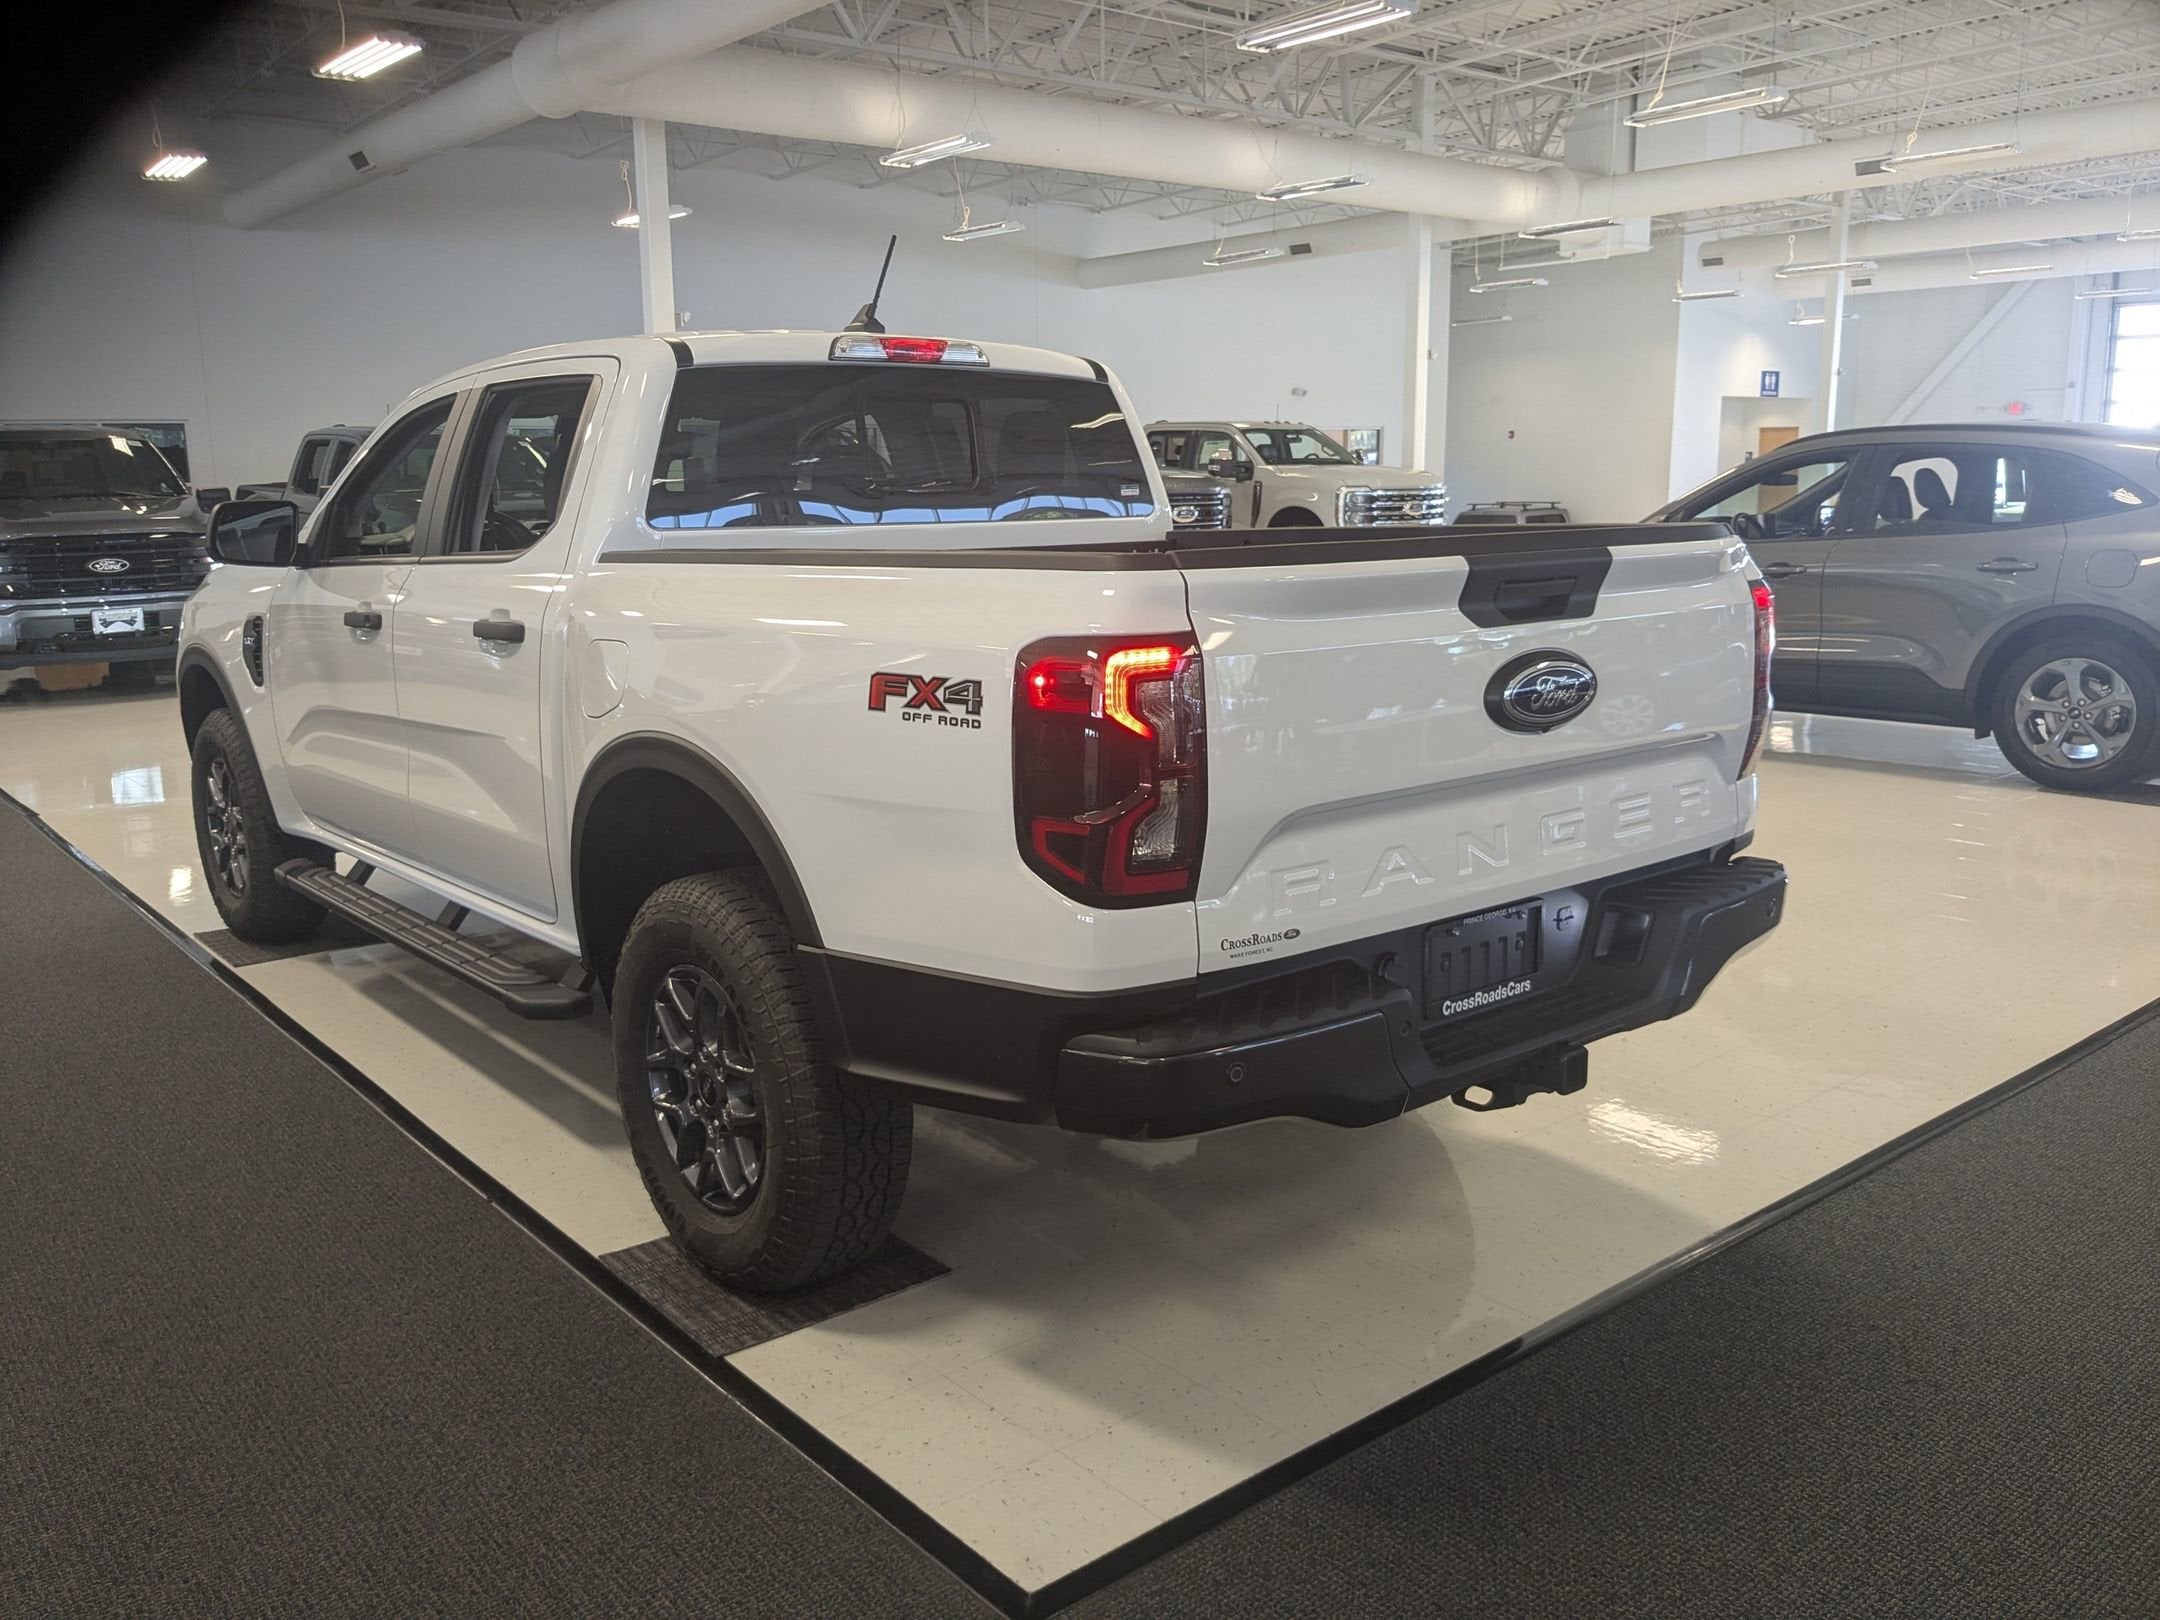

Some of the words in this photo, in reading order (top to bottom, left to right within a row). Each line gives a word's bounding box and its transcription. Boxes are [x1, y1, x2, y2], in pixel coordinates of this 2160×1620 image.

[868, 672, 984, 716] FX4
[1530, 676, 1579, 711] Ford
[902, 711, 932, 723] OFF
[938, 715, 982, 729] ROAD
[1271, 779, 1711, 917] RANGER
[1463, 914, 1484, 925] PRINCE
[1442, 979, 1531, 1016] CrossRoadsCars
